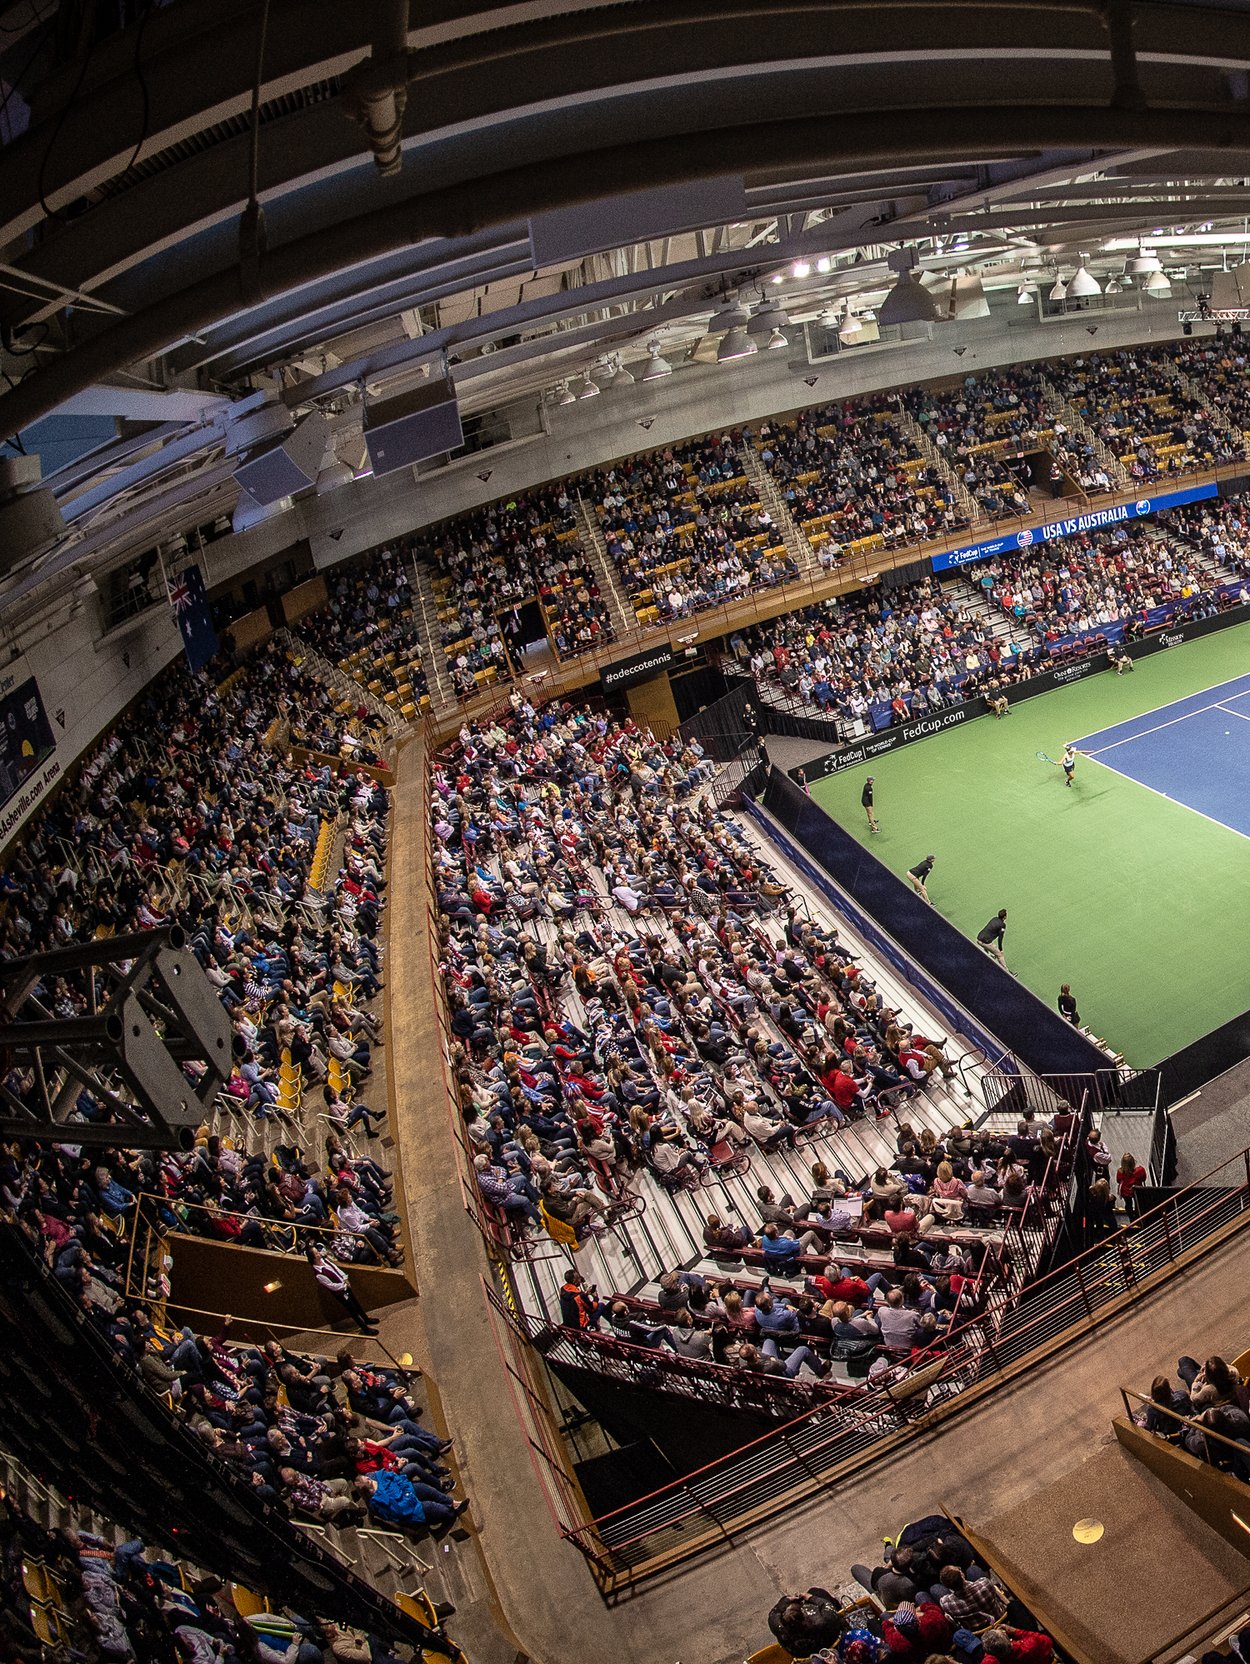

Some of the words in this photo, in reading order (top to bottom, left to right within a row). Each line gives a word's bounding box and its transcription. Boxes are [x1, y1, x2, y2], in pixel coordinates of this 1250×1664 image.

[1042, 522, 1063, 540] USA
[1063, 518, 1078, 534] VS
[1078, 505, 1129, 531] AUSTRALIA
[959, 549, 979, 560] FedCup
[605, 651, 672, 685] #adeccotennis
[902, 709, 966, 741] FedCup.com
[838, 749, 863, 764] FedCup
[42, 762, 61, 786] Arena
